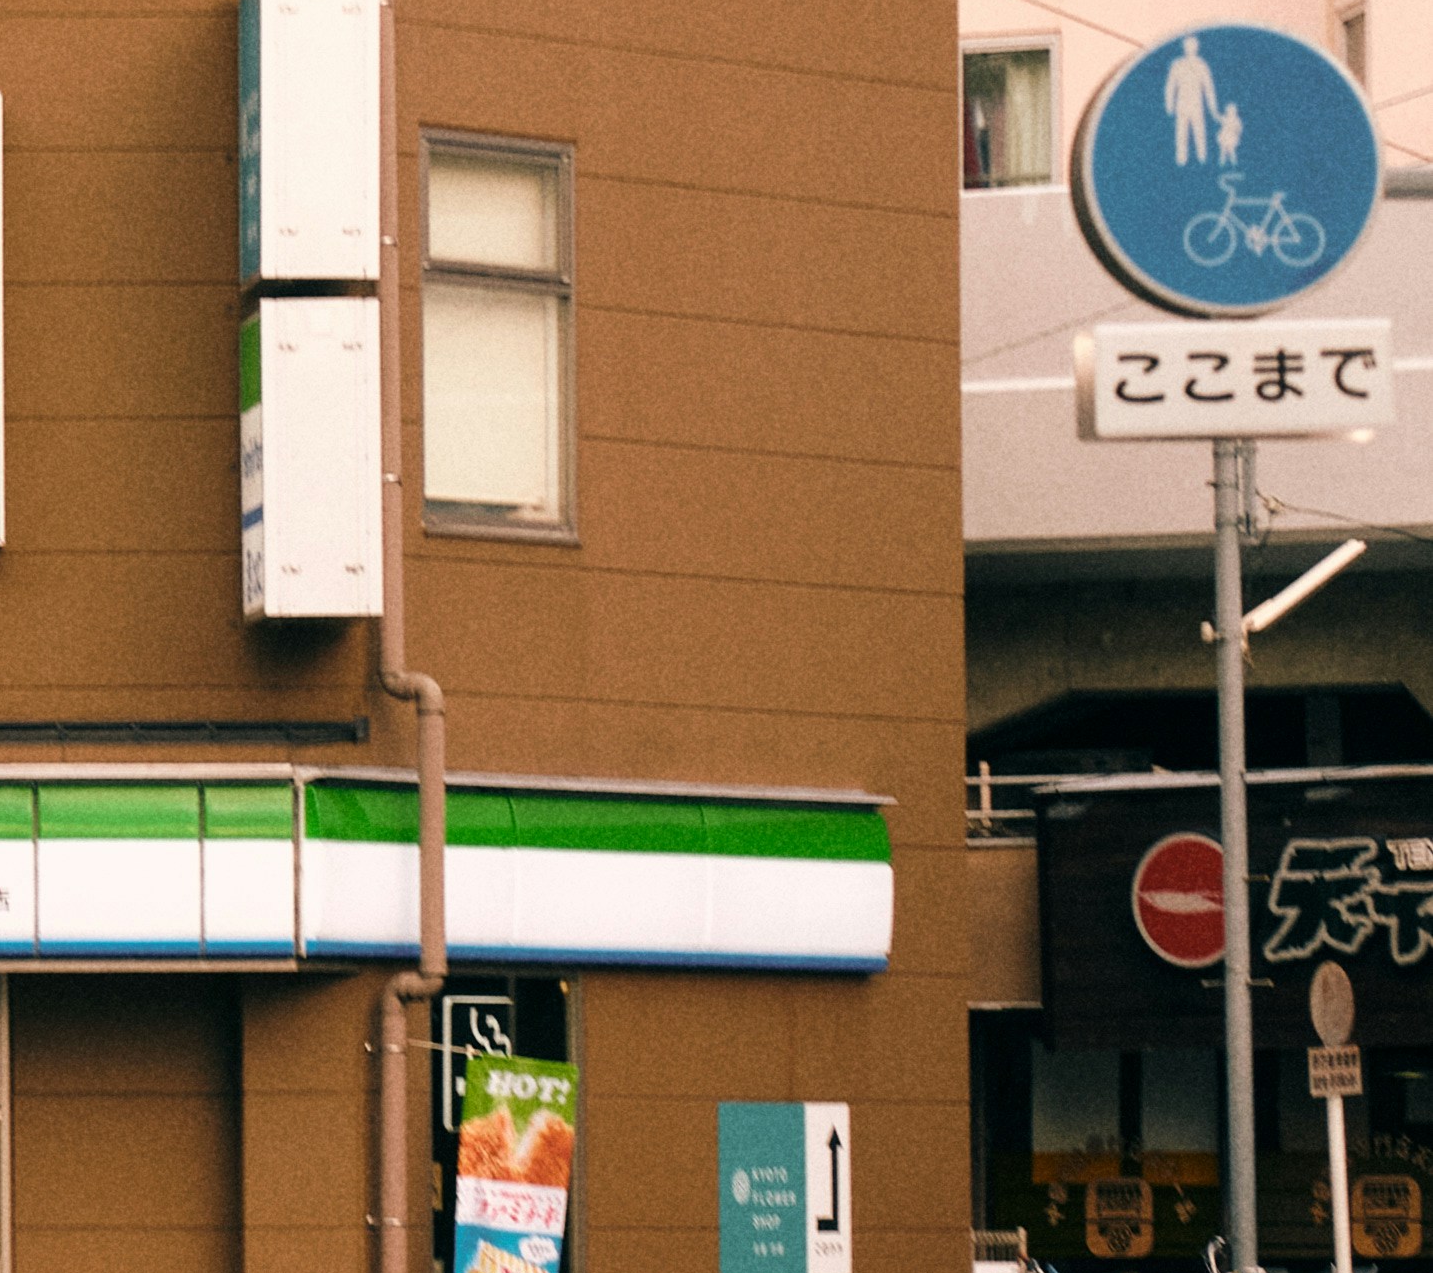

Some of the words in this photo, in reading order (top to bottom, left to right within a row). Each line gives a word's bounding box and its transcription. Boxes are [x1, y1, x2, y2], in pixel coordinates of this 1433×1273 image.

[1115, 347, 1377, 402] ここまで
[485, 1069, 571, 1105] HOT!
